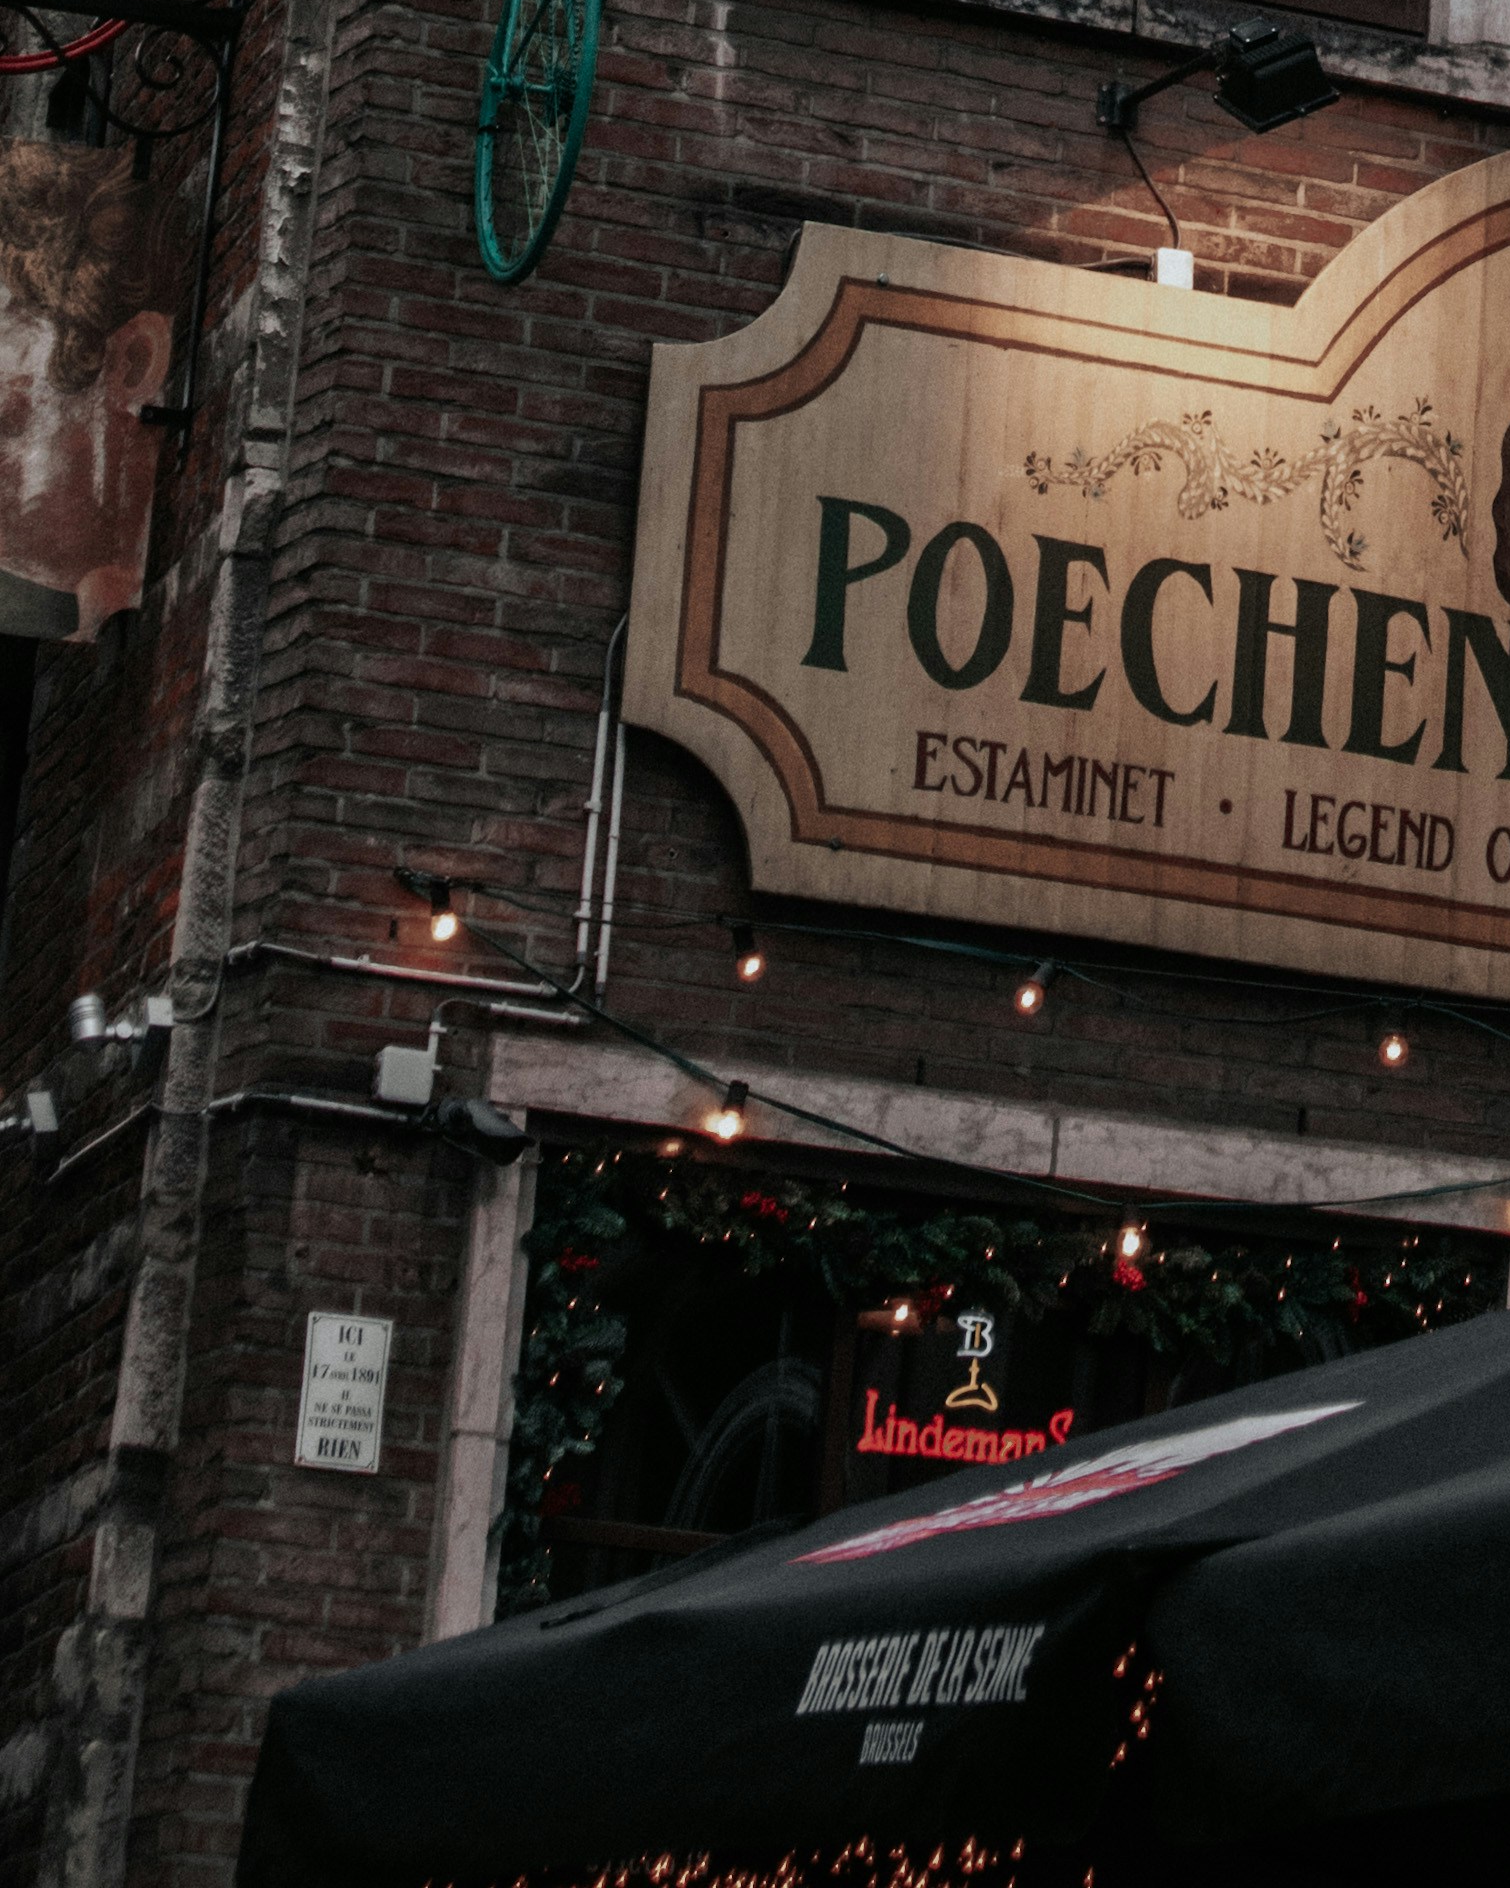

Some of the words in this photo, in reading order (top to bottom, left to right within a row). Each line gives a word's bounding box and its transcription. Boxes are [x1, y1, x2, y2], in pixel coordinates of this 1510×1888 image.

[911, 731, 1176, 829] ESTAMINET
[1282, 789, 1455, 873] LEGEND
[338, 1325, 364, 1346] ICI
[312, 1363, 330, 1380] 17
[314, 1402, 329, 1413] NE
[331, 1403, 343, 1415] SE
[345, 1405, 372, 1417] PASSA
[308, 1416, 375, 1432] STRICTEMENT
[317, 1437, 362, 1460] RIEN
[795, 1629, 922, 1715] BRASSERIE
[905, 1624, 951, 1706] DE
[935, 1623, 976, 1704] LA
[963, 1621, 1046, 1704] SENNE
[858, 1720, 924, 1766] BRUSSELS
